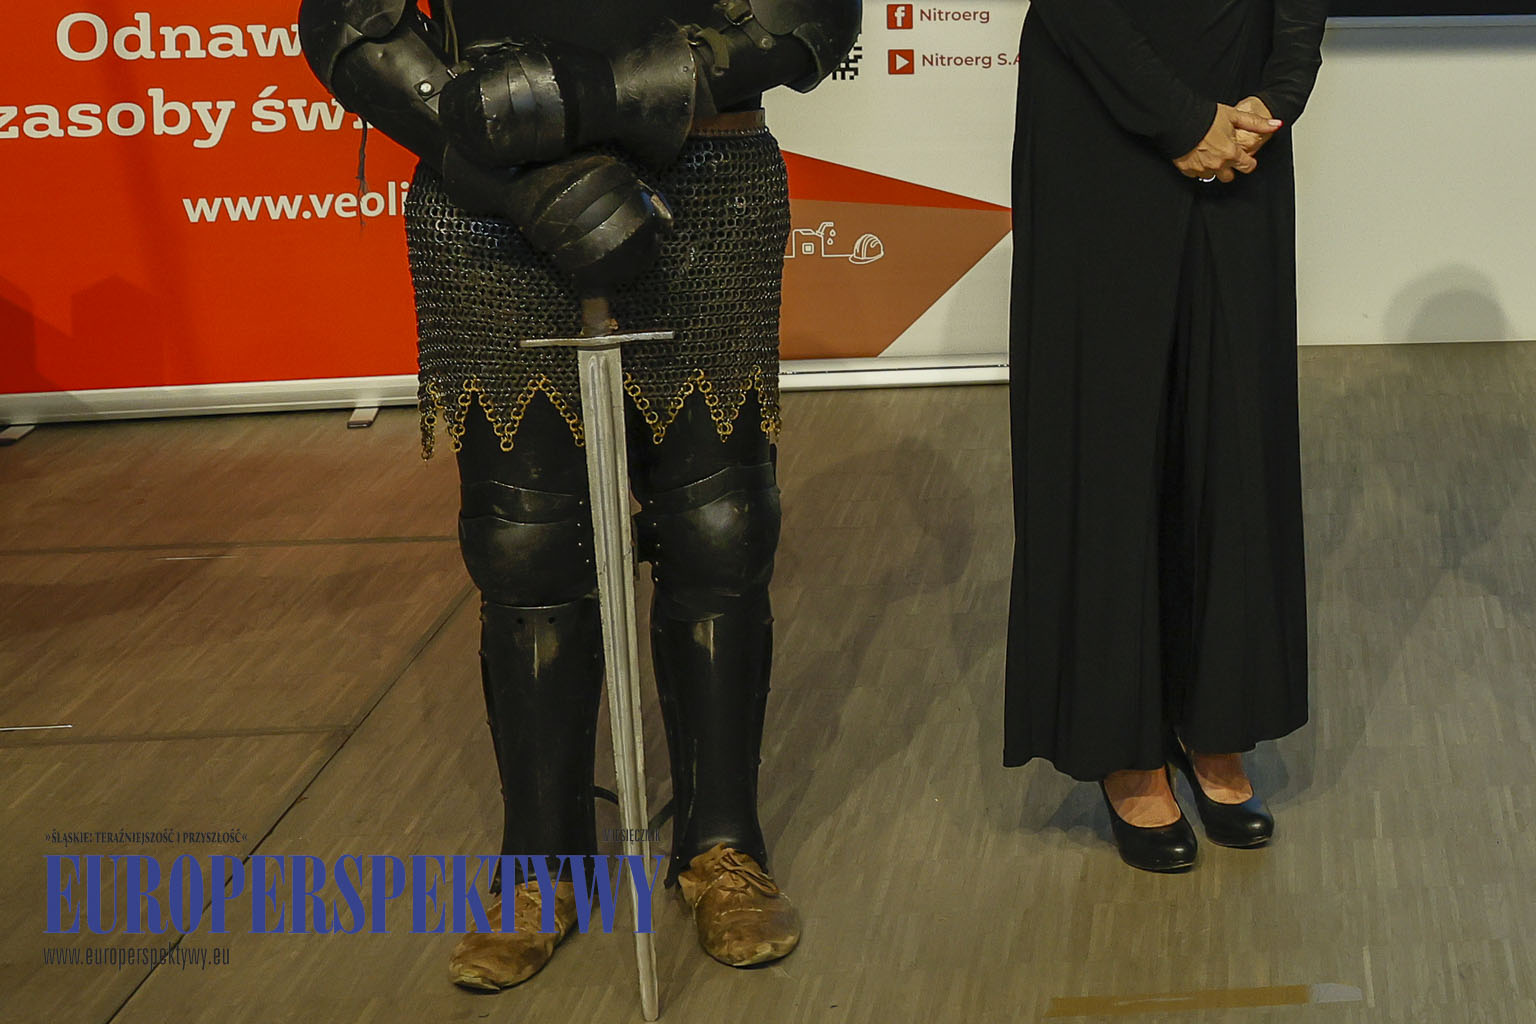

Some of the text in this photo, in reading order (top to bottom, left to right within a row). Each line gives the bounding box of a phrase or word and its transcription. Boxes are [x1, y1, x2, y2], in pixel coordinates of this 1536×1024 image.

[920, 8, 990, 24] Nitroerg
[922, 53, 992, 69] Nitroerg
[0, 88, 236, 149] zasoby
